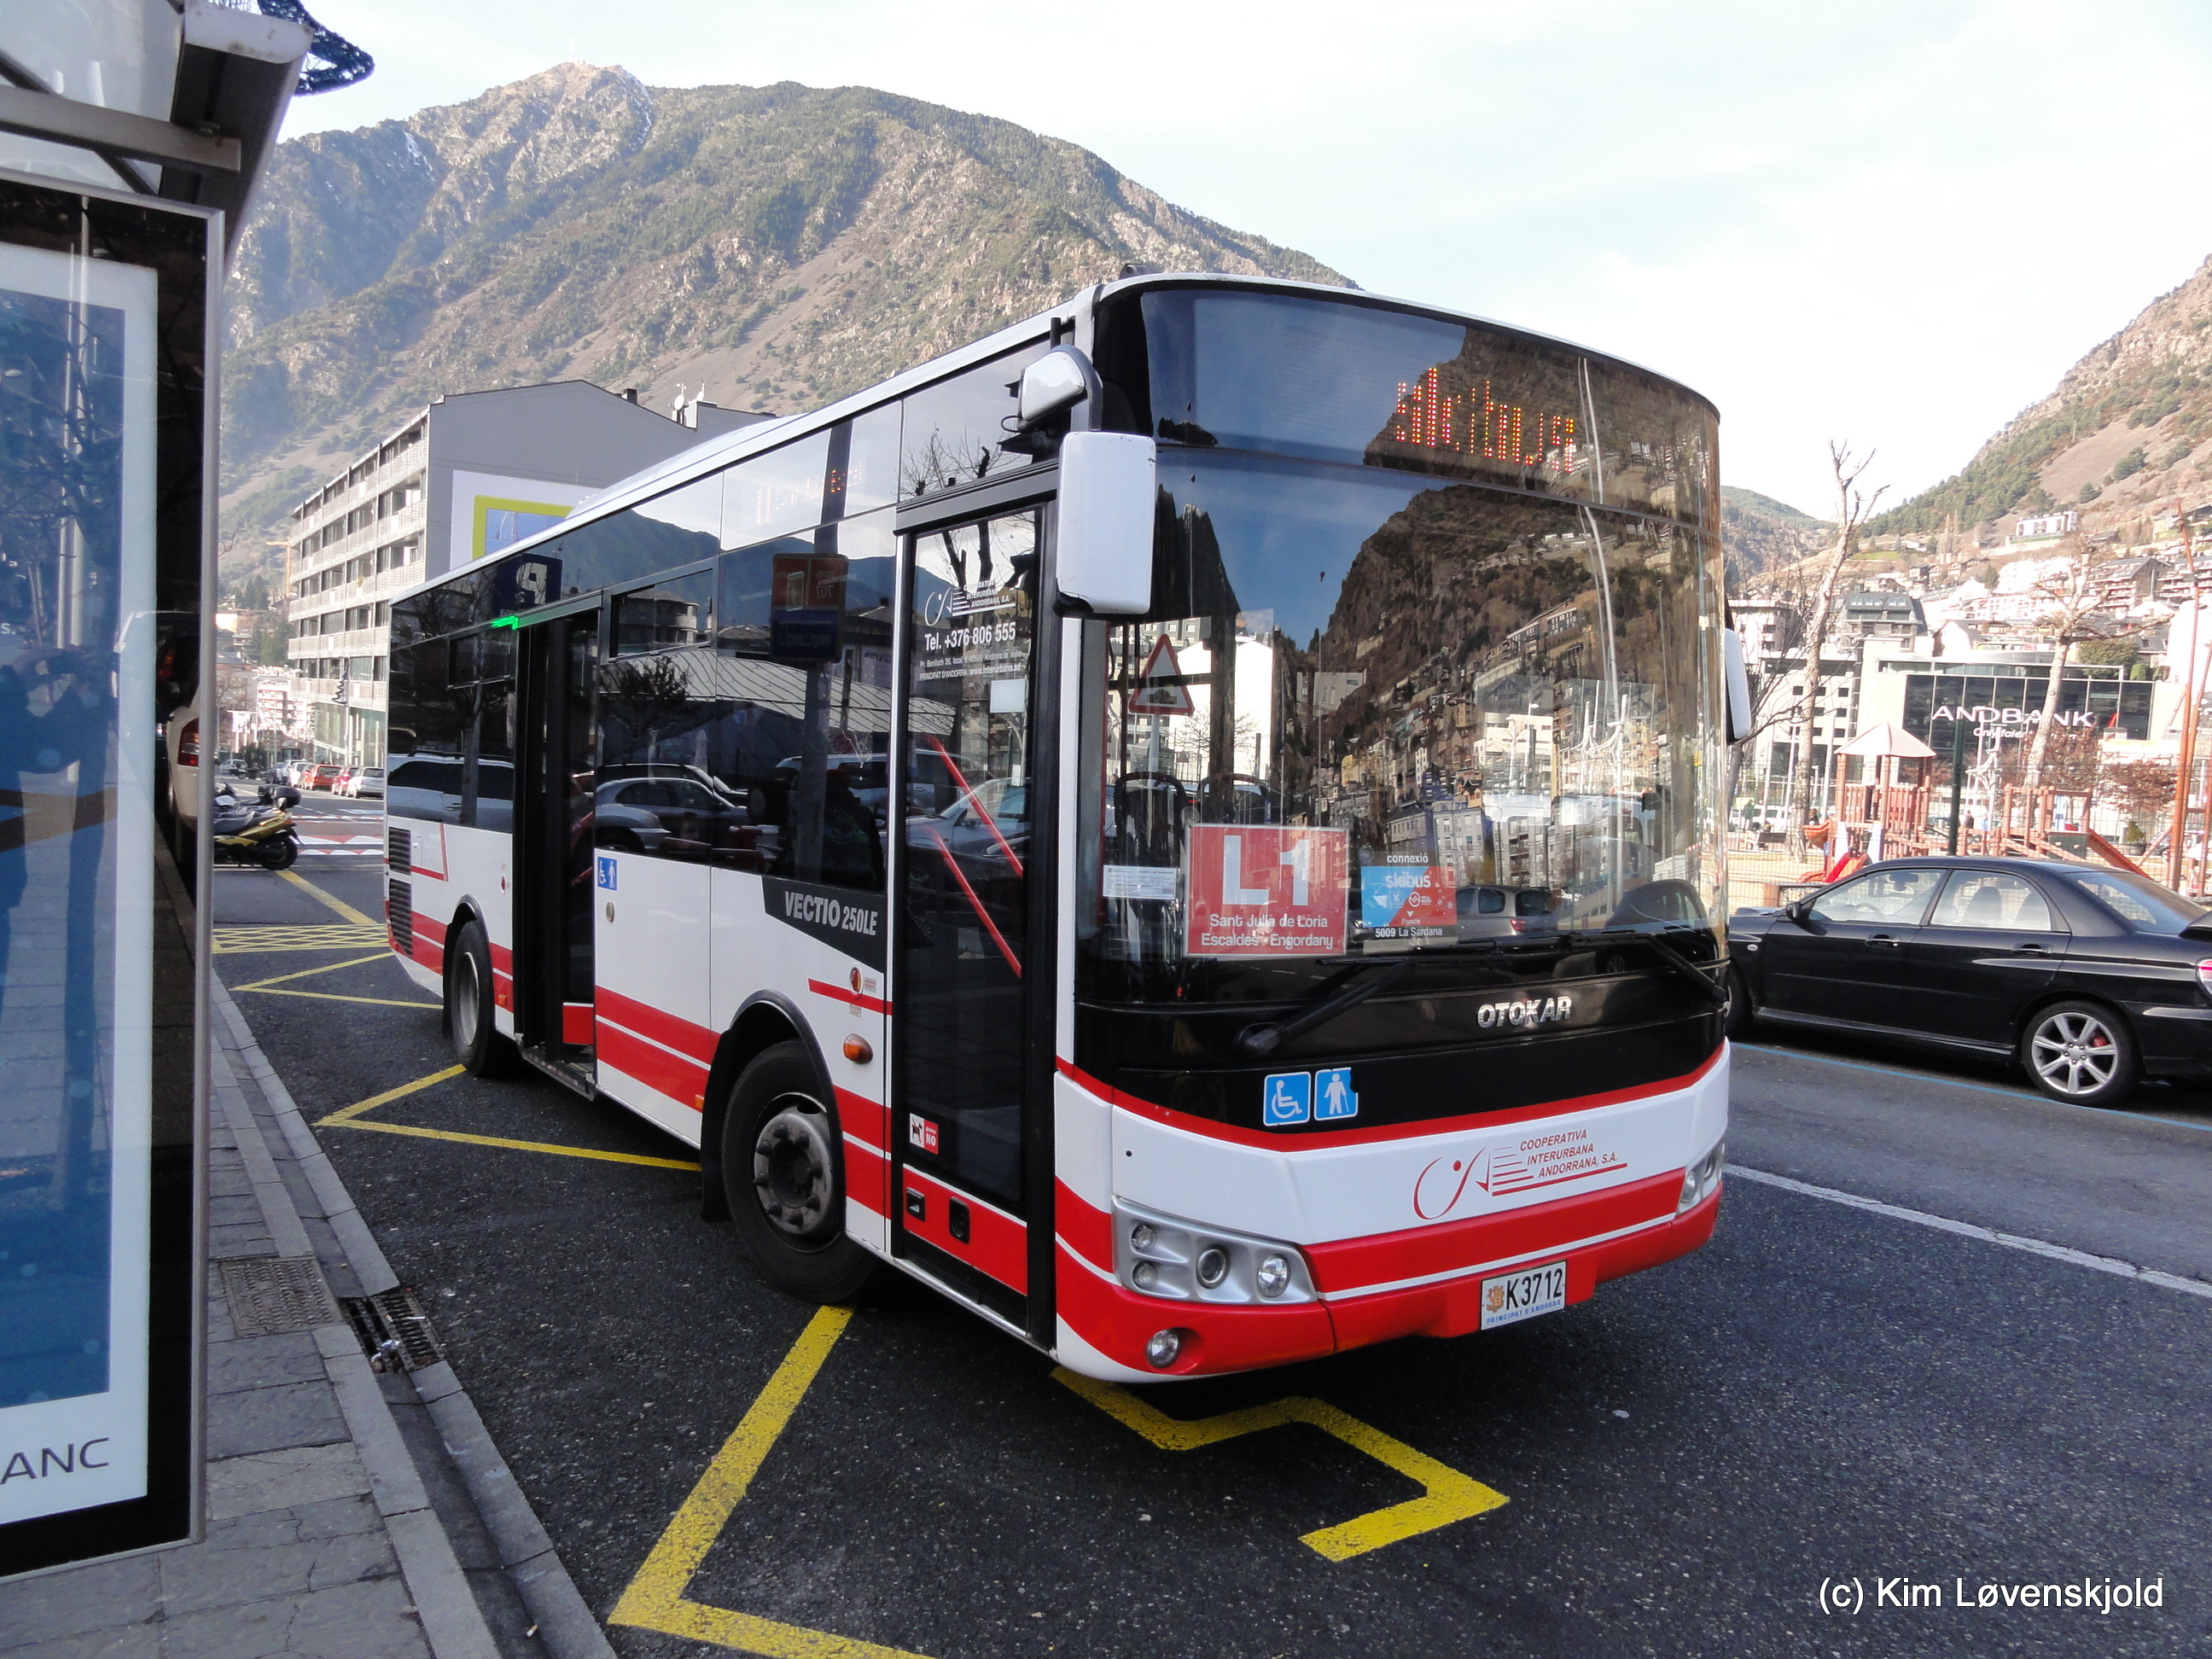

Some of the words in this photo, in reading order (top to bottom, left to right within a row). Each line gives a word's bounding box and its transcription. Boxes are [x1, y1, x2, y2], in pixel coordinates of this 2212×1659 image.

[924, 632, 942, 651] Tel.
[945, 628, 969, 649] +376
[973, 625, 992, 645] 806
[995, 621, 1016, 642] 555
[1222, 835, 1309, 905] L1
[1387, 853, 1429, 864] connexió
[1385, 871, 1431, 888] skibus
[785, 891, 841, 928] VECTIO
[841, 905, 878, 936] 250LE
[1209, 913, 1243, 928] Sant
[1246, 914, 1276, 928] Julià
[1279, 915, 1295, 928] de
[1297, 914, 1328, 928] Lòria
[1201, 933, 1259, 946] Escaldes
[1270, 934, 1333, 950] Engordany
[1375, 928, 1396, 938] 5009
[1398, 928, 1409, 937] La
[1411, 927, 1443, 936] Sardana
[1477, 996, 1572, 1028] OTOKAR
[926, 1132, 936, 1147] NO
[1520, 1129, 1587, 1151] COOPERATIVA
[1527, 1143, 1594, 1166] INTERURBANA
[1538, 1156, 1599, 1178] ANDORRANA,
[1601, 1152, 1618, 1164] S.A.
[1506, 1268, 1563, 1311] K3712
[1486, 1311, 1523, 1324] PRINCIPAT
[1524, 1299, 1561, 1315] D'ANDORRA
